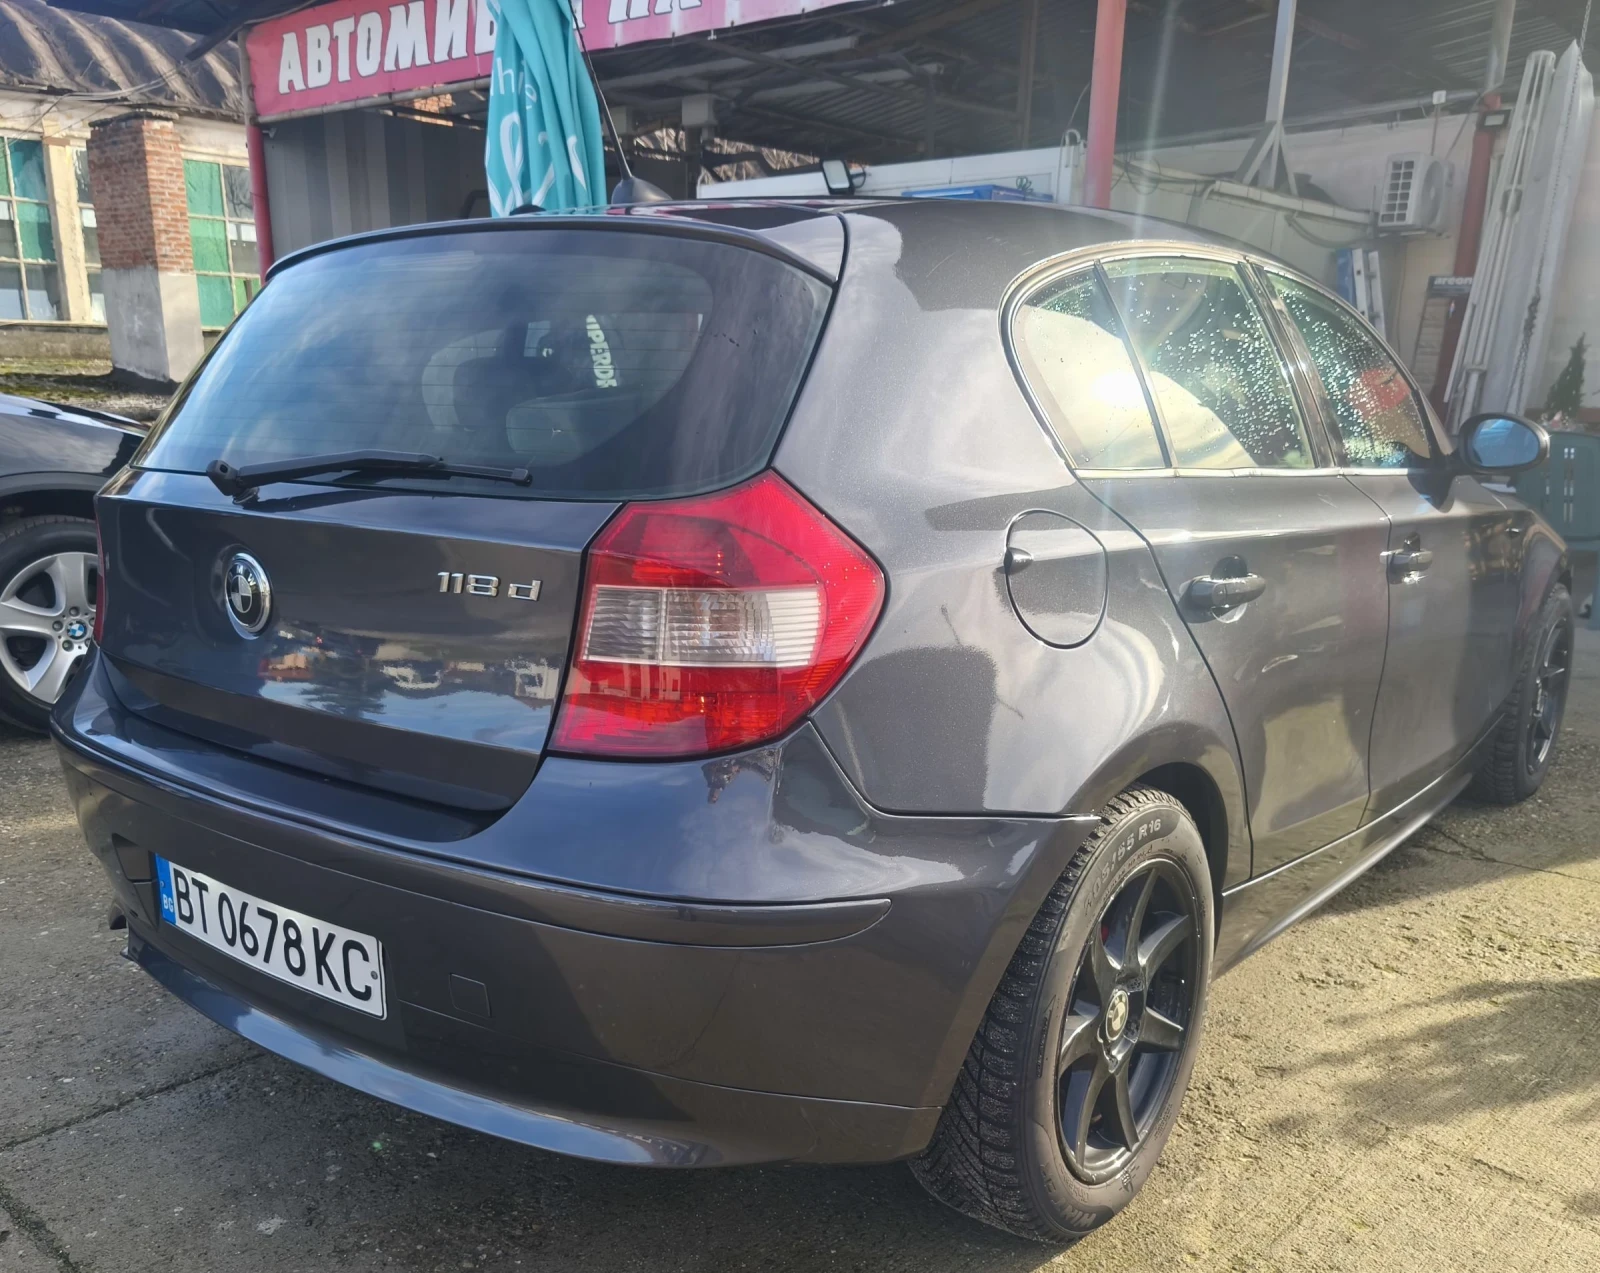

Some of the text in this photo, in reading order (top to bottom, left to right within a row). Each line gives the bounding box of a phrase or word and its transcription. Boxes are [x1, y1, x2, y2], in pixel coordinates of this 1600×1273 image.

[437, 571, 542, 601] 118 d
[1138, 818, 1162, 841] R16
[163, 893, 175, 913] BG
[173, 867, 209, 935] BT
